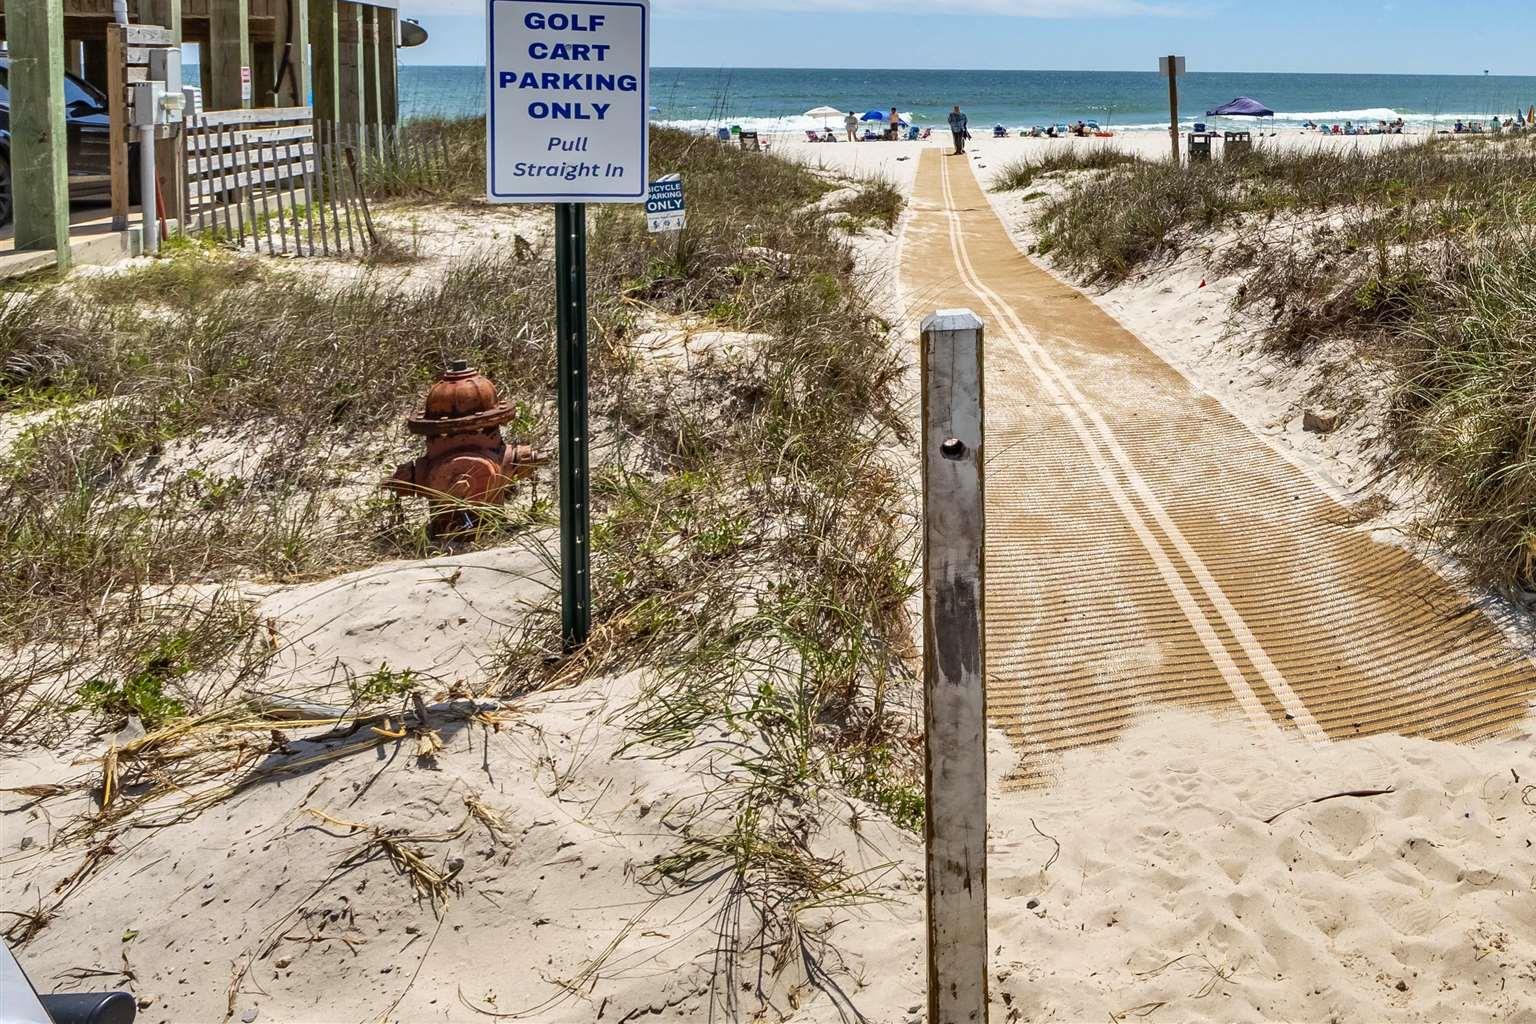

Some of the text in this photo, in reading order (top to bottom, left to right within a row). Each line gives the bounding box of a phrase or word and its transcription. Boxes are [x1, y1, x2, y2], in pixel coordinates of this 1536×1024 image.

[524, 12, 605, 32] GOLF
[528, 42, 610, 61] CART
[499, 71, 637, 92] PARKING
[527, 102, 610, 120] ONLY
[547, 137, 588, 152] Pull
[513, 162, 624, 181] Straight In
[647, 199, 682, 211] ONLY
